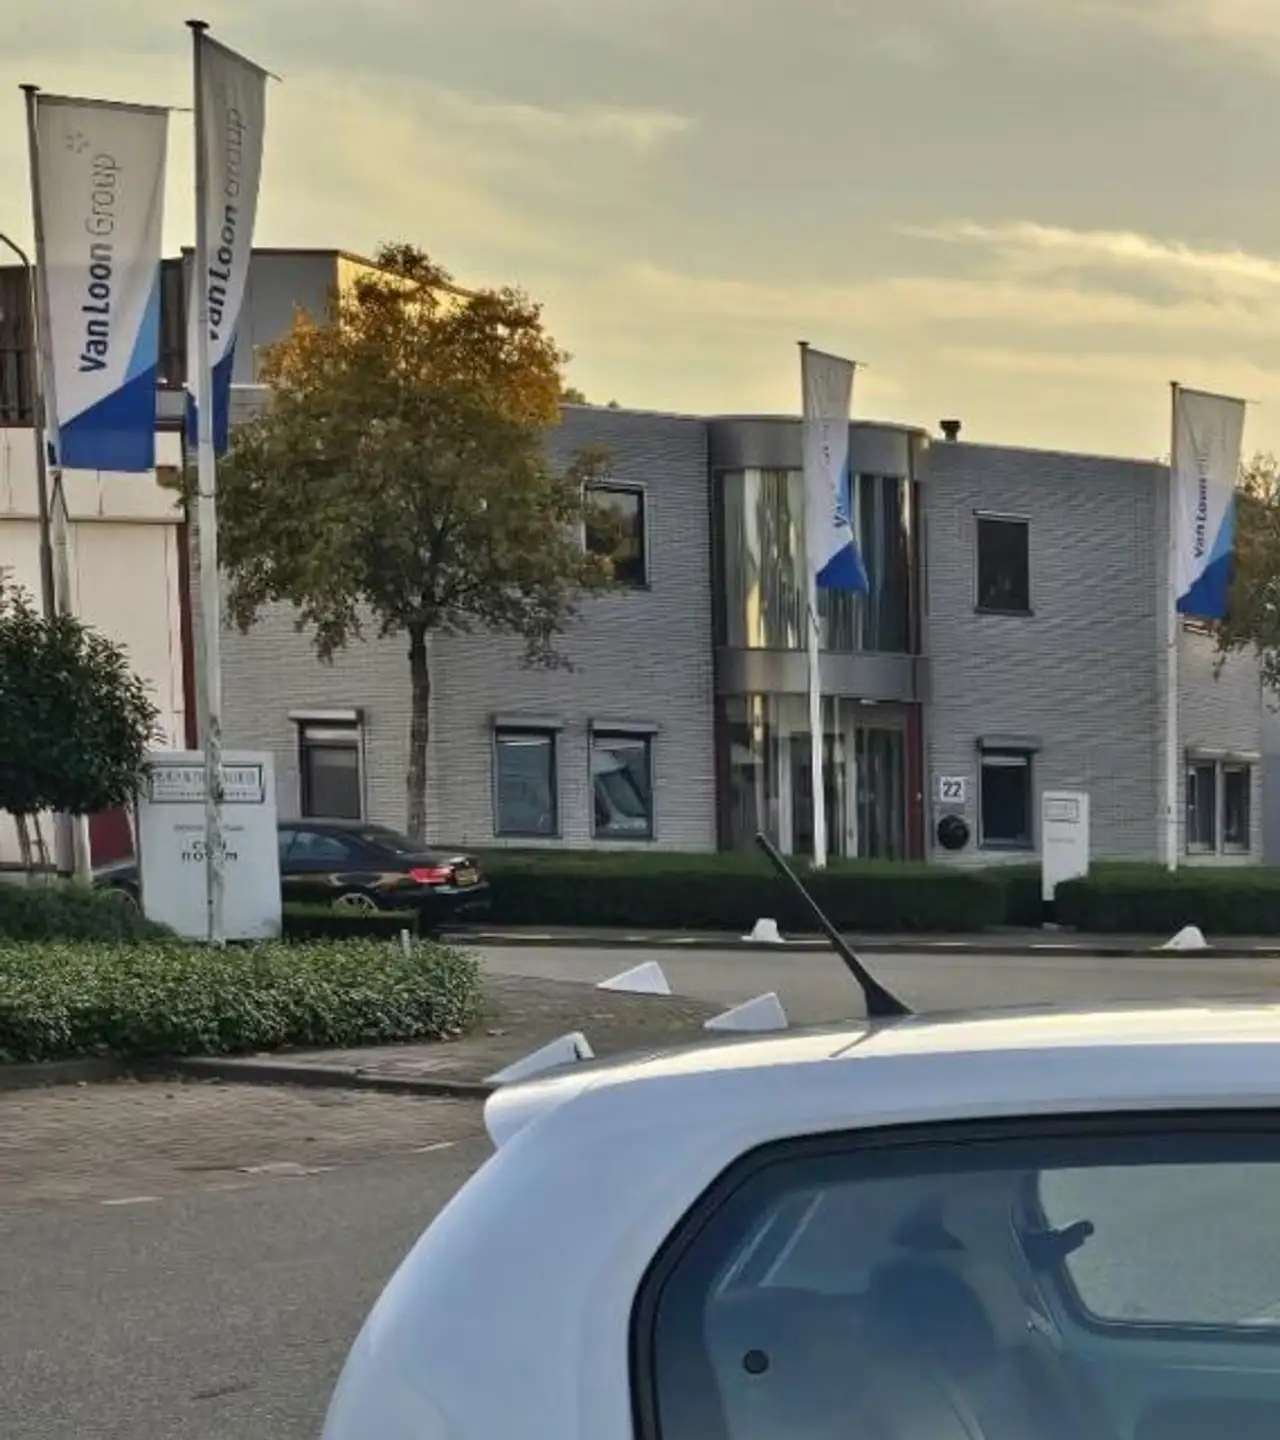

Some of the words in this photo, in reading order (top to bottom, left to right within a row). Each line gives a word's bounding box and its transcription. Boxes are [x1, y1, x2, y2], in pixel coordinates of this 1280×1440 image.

[85, 153, 123, 236] Group
[82, 243, 113, 313] Loon
[209, 204, 240, 282] Loon
[79, 320, 109, 373] Van
[942, 781, 962, 797] 22
